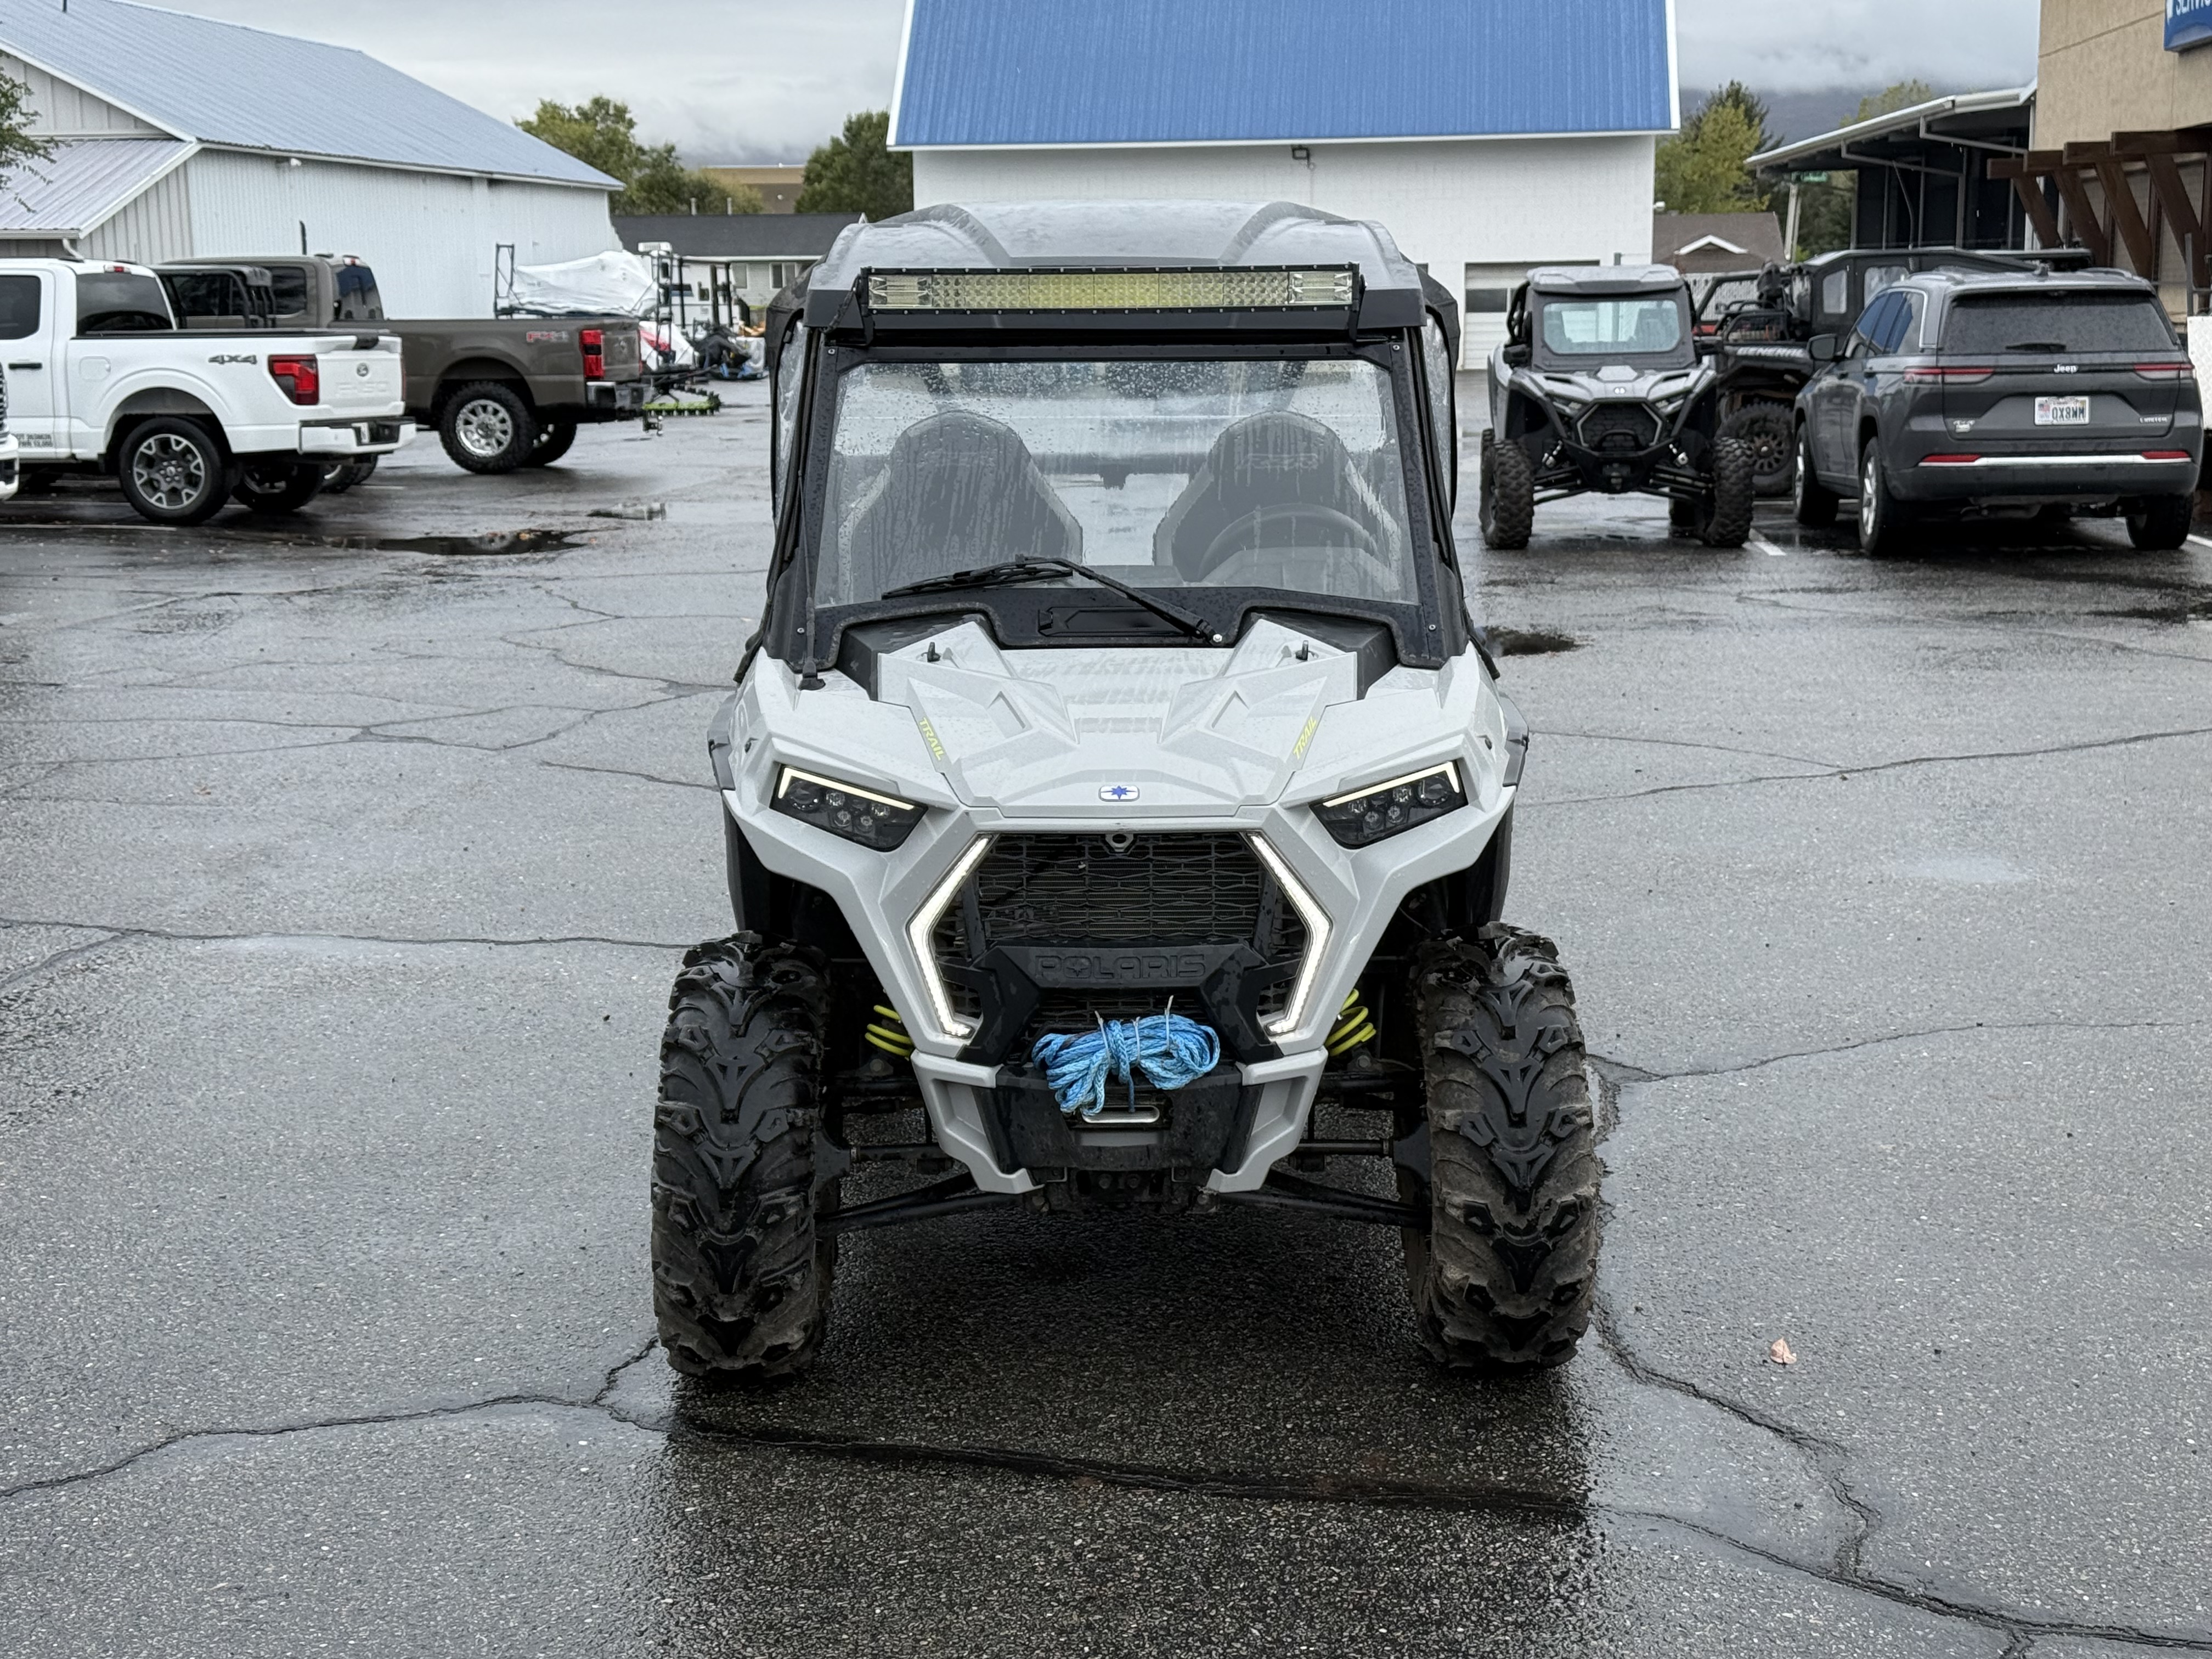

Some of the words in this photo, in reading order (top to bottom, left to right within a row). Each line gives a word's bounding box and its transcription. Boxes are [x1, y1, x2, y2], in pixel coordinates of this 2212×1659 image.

[2054, 364, 2078, 374] Jeep
[919, 716, 944, 760] TRAIL
[1293, 715, 1316, 760] TRAIL
[1035, 955, 1205, 979] POLARIS
